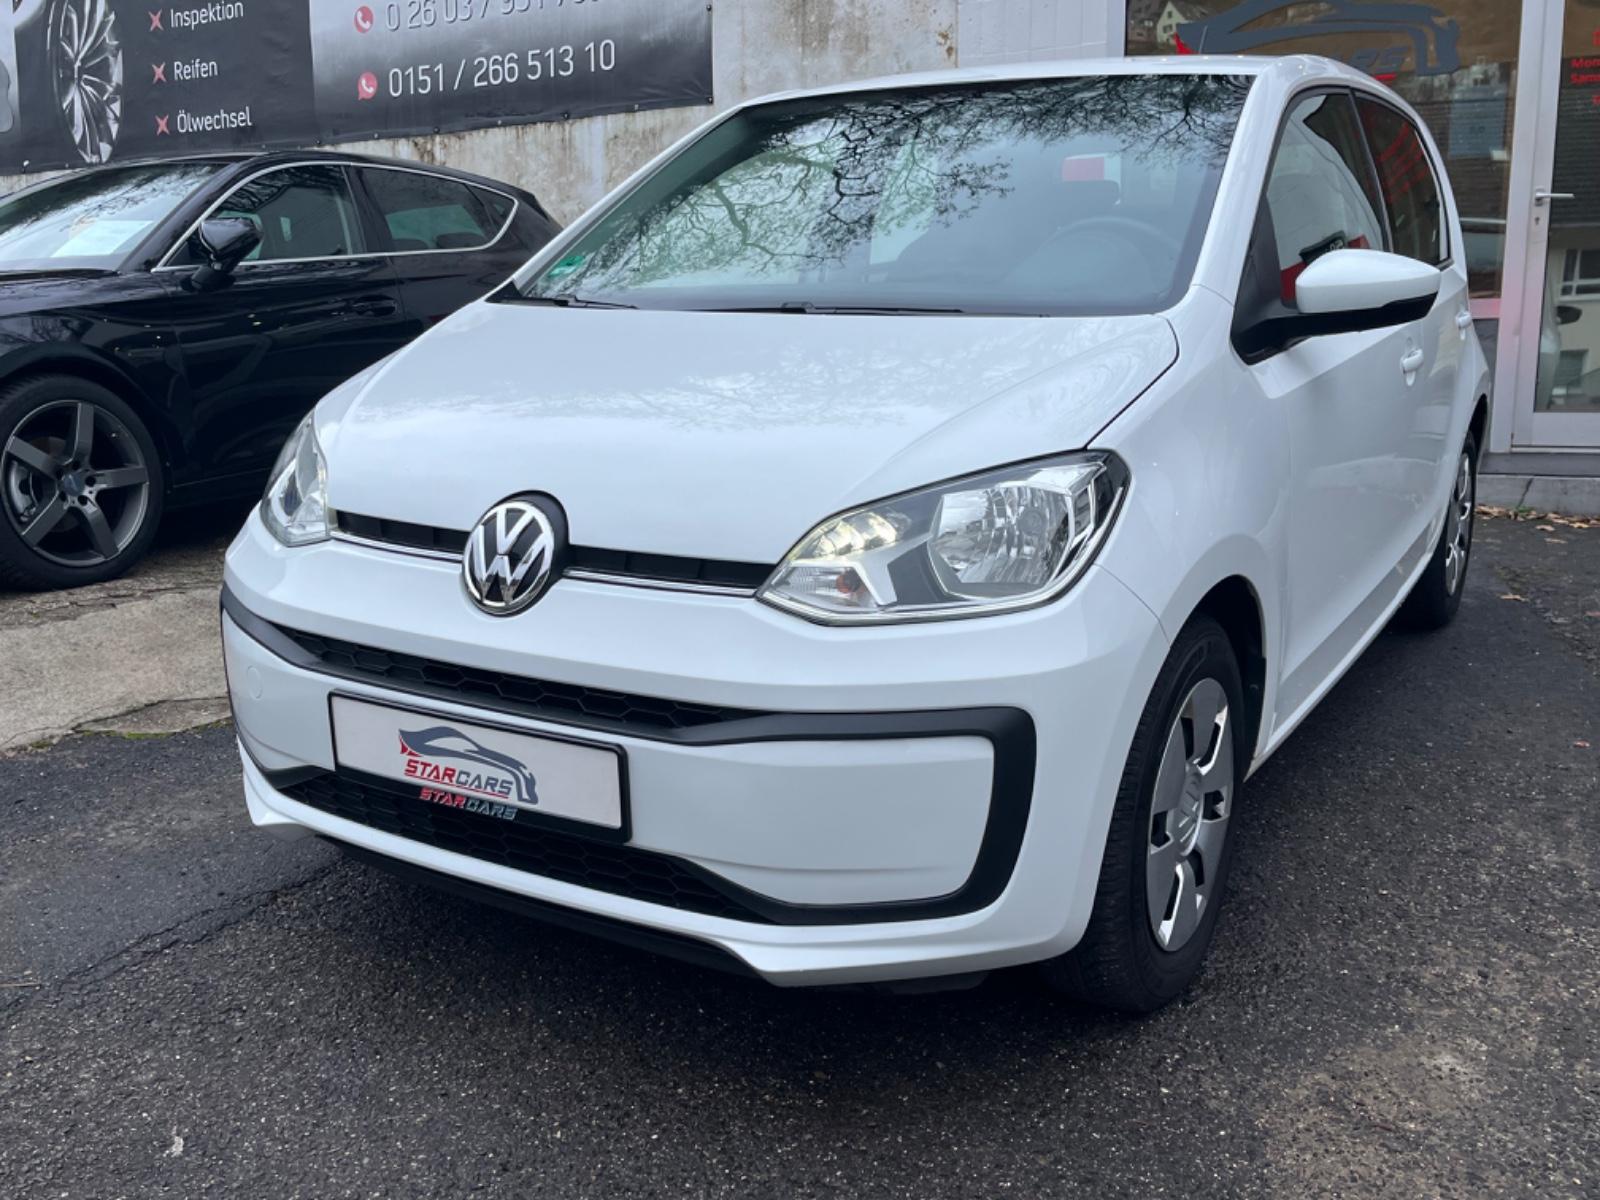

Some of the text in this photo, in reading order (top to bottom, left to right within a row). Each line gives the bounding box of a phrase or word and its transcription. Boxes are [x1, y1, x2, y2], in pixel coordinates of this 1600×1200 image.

[170, 1, 244, 30] Inspektion
[385, 2, 401, 31] 0
[407, 0, 437, 29] 26
[173, 58, 218, 81] Reifen
[388, 39, 615, 97] 0151 / 266 513 10
[177, 105, 252, 133] Ölwechsel
[405, 759, 514, 796] STARCARS
[419, 787, 519, 820] STARCARS
